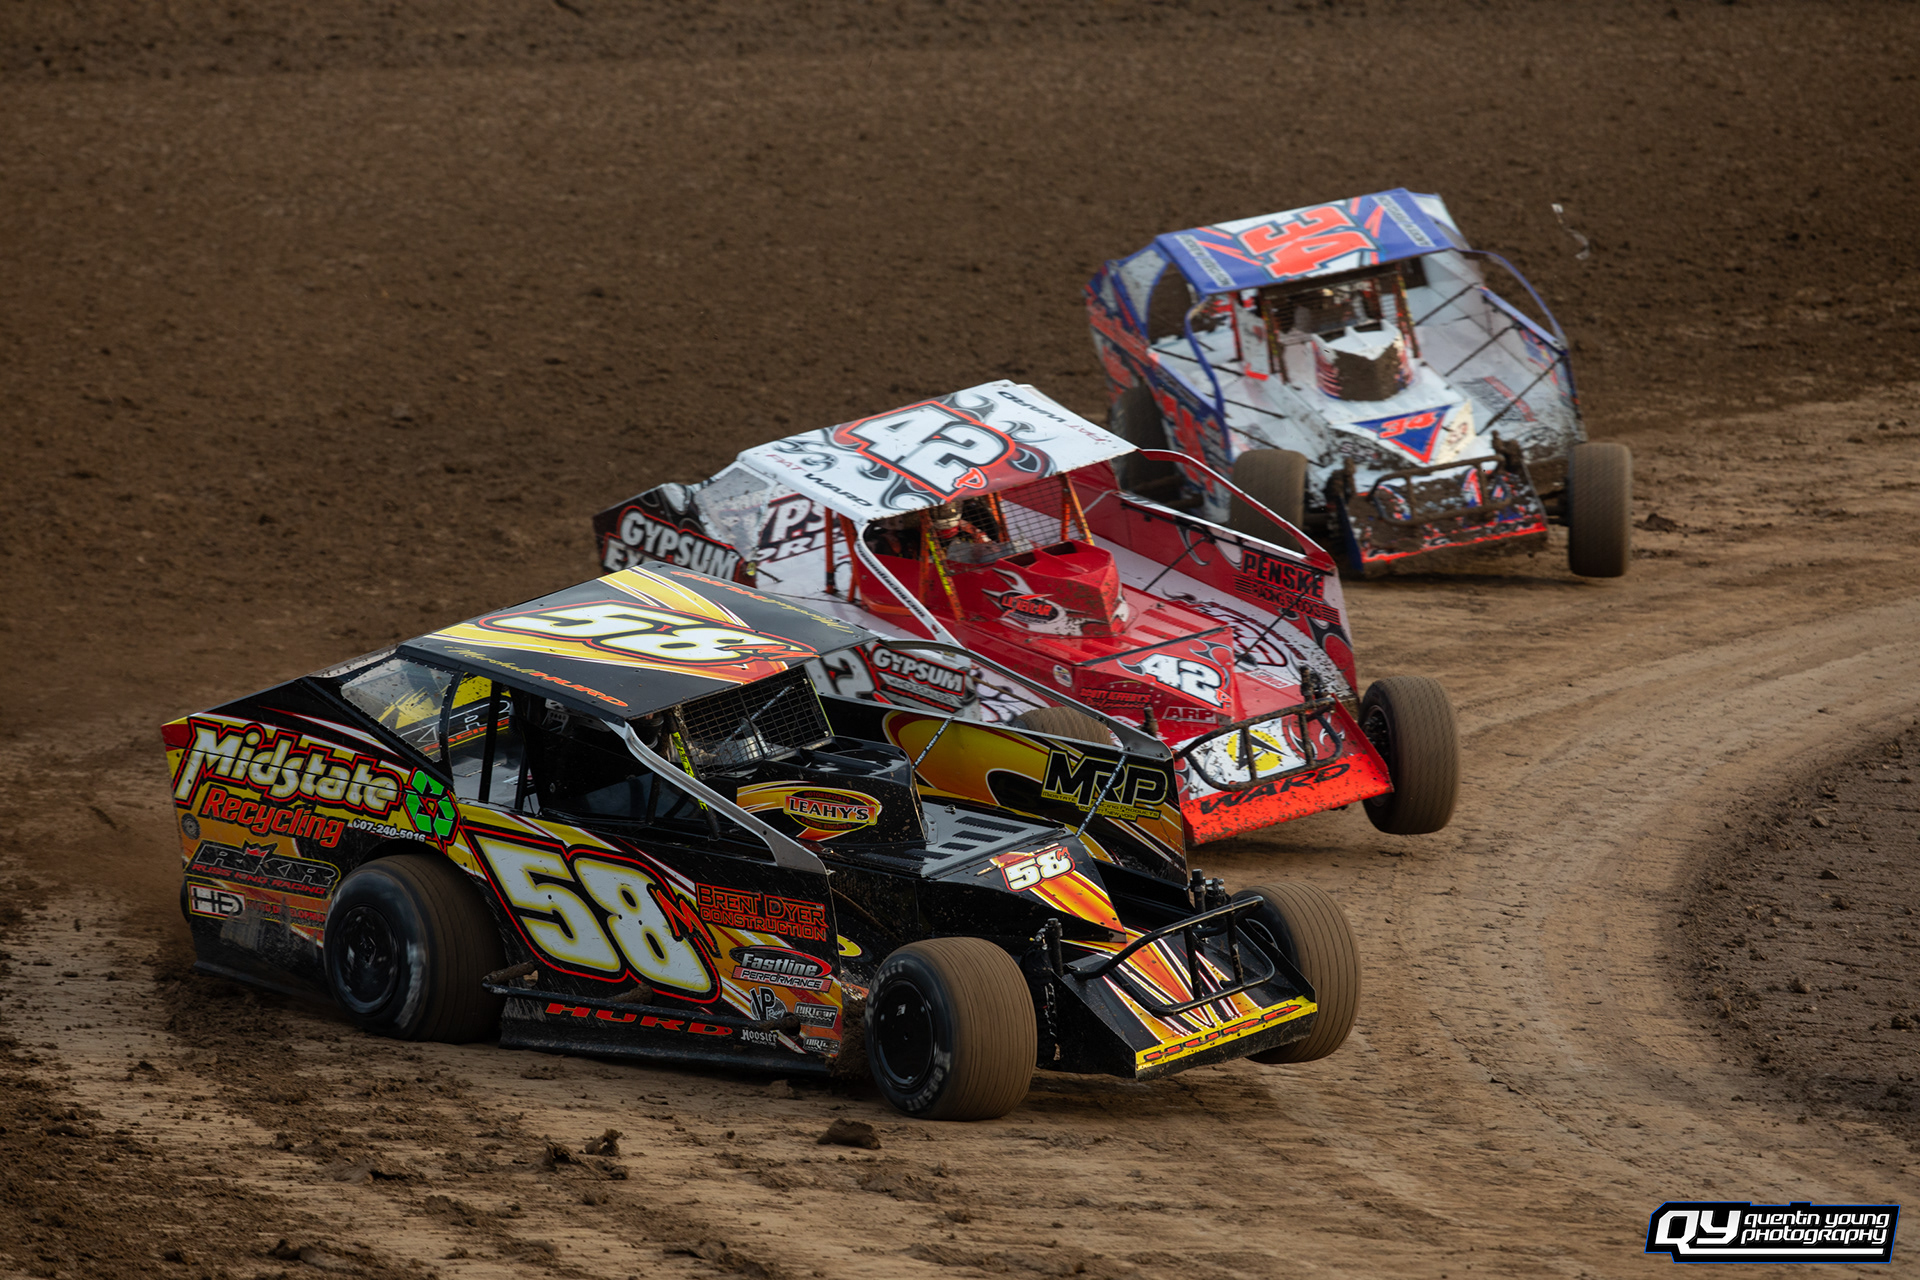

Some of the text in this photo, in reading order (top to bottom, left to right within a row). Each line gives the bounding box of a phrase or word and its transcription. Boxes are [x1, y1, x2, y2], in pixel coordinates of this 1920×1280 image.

[1238, 206, 1374, 278] 34
[619, 511, 741, 582] GYPSUM
[1243, 553, 1324, 599] PENSKE
[872, 647, 964, 692] GYPSUM
[1163, 707, 1214, 720] ARP
[174, 726, 400, 811] Midstate
[1044, 750, 1168, 806] MRP
[1200, 763, 1350, 815] WARD
[201, 787, 345, 848] Recycling
[789, 799, 869, 820] LEAHY'S
[271, 878, 327, 896] RACING
[695, 882, 829, 928] BRENT DYER
[700, 907, 827, 942] CONSTRUCTION
[741, 953, 819, 978] Fastline
[741, 970, 823, 989] PERFORMANCE
